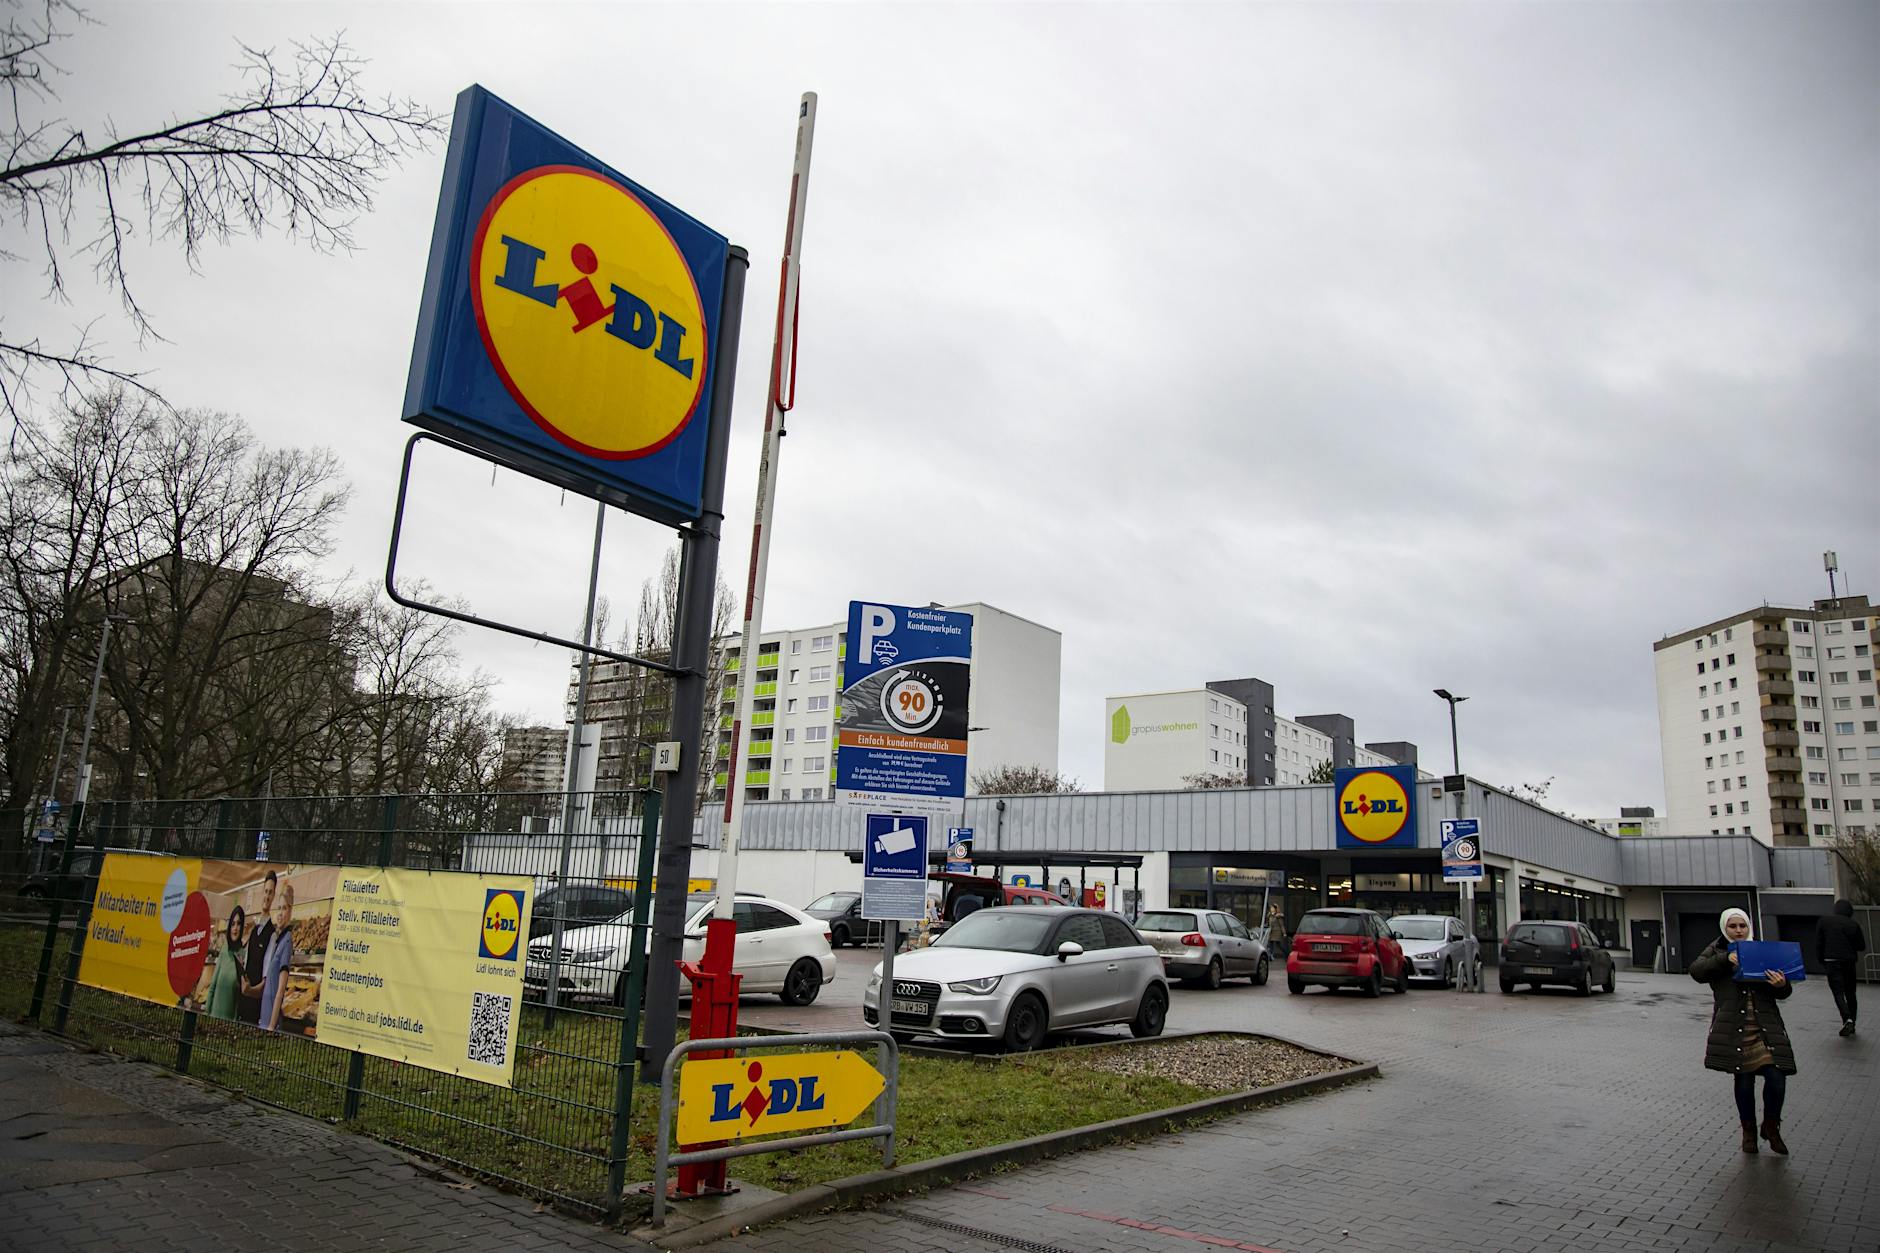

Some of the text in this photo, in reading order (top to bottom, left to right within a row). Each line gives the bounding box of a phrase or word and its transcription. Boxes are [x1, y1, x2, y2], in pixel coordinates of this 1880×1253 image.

[907, 609, 947, 622] Kostenfreier
[858, 604, 896, 664] P
[907, 621, 962, 635] Kundenparkplatz
[899, 692, 925, 712] 90
[1132, 722, 1198, 736] gropiuswohnen
[858, 734, 949, 751] Einfach kundenfreundlich
[660, 750, 670, 764] 50
[1442, 822, 1454, 841] P
[873, 866, 918, 874] Sicherheitskameras
[342, 880, 380, 894] Filialleiter
[98, 891, 144, 915] Mitarbeiter
[145, 896, 157, 918] im
[338, 908, 400, 926] Stellv. Filialleiter
[92, 921, 125, 944] Verkauf
[334, 938, 370, 954] Verkäufer
[329, 968, 384, 989] Studentenjobs
[476, 963, 487, 973] Lidl
[488, 965, 504, 976] lohnt
[504, 967, 516, 978] sich
[914, 1003, 927, 1013] 151
[325, 1002, 424, 1034] Bewirb dich auf jobs.lidl.de
